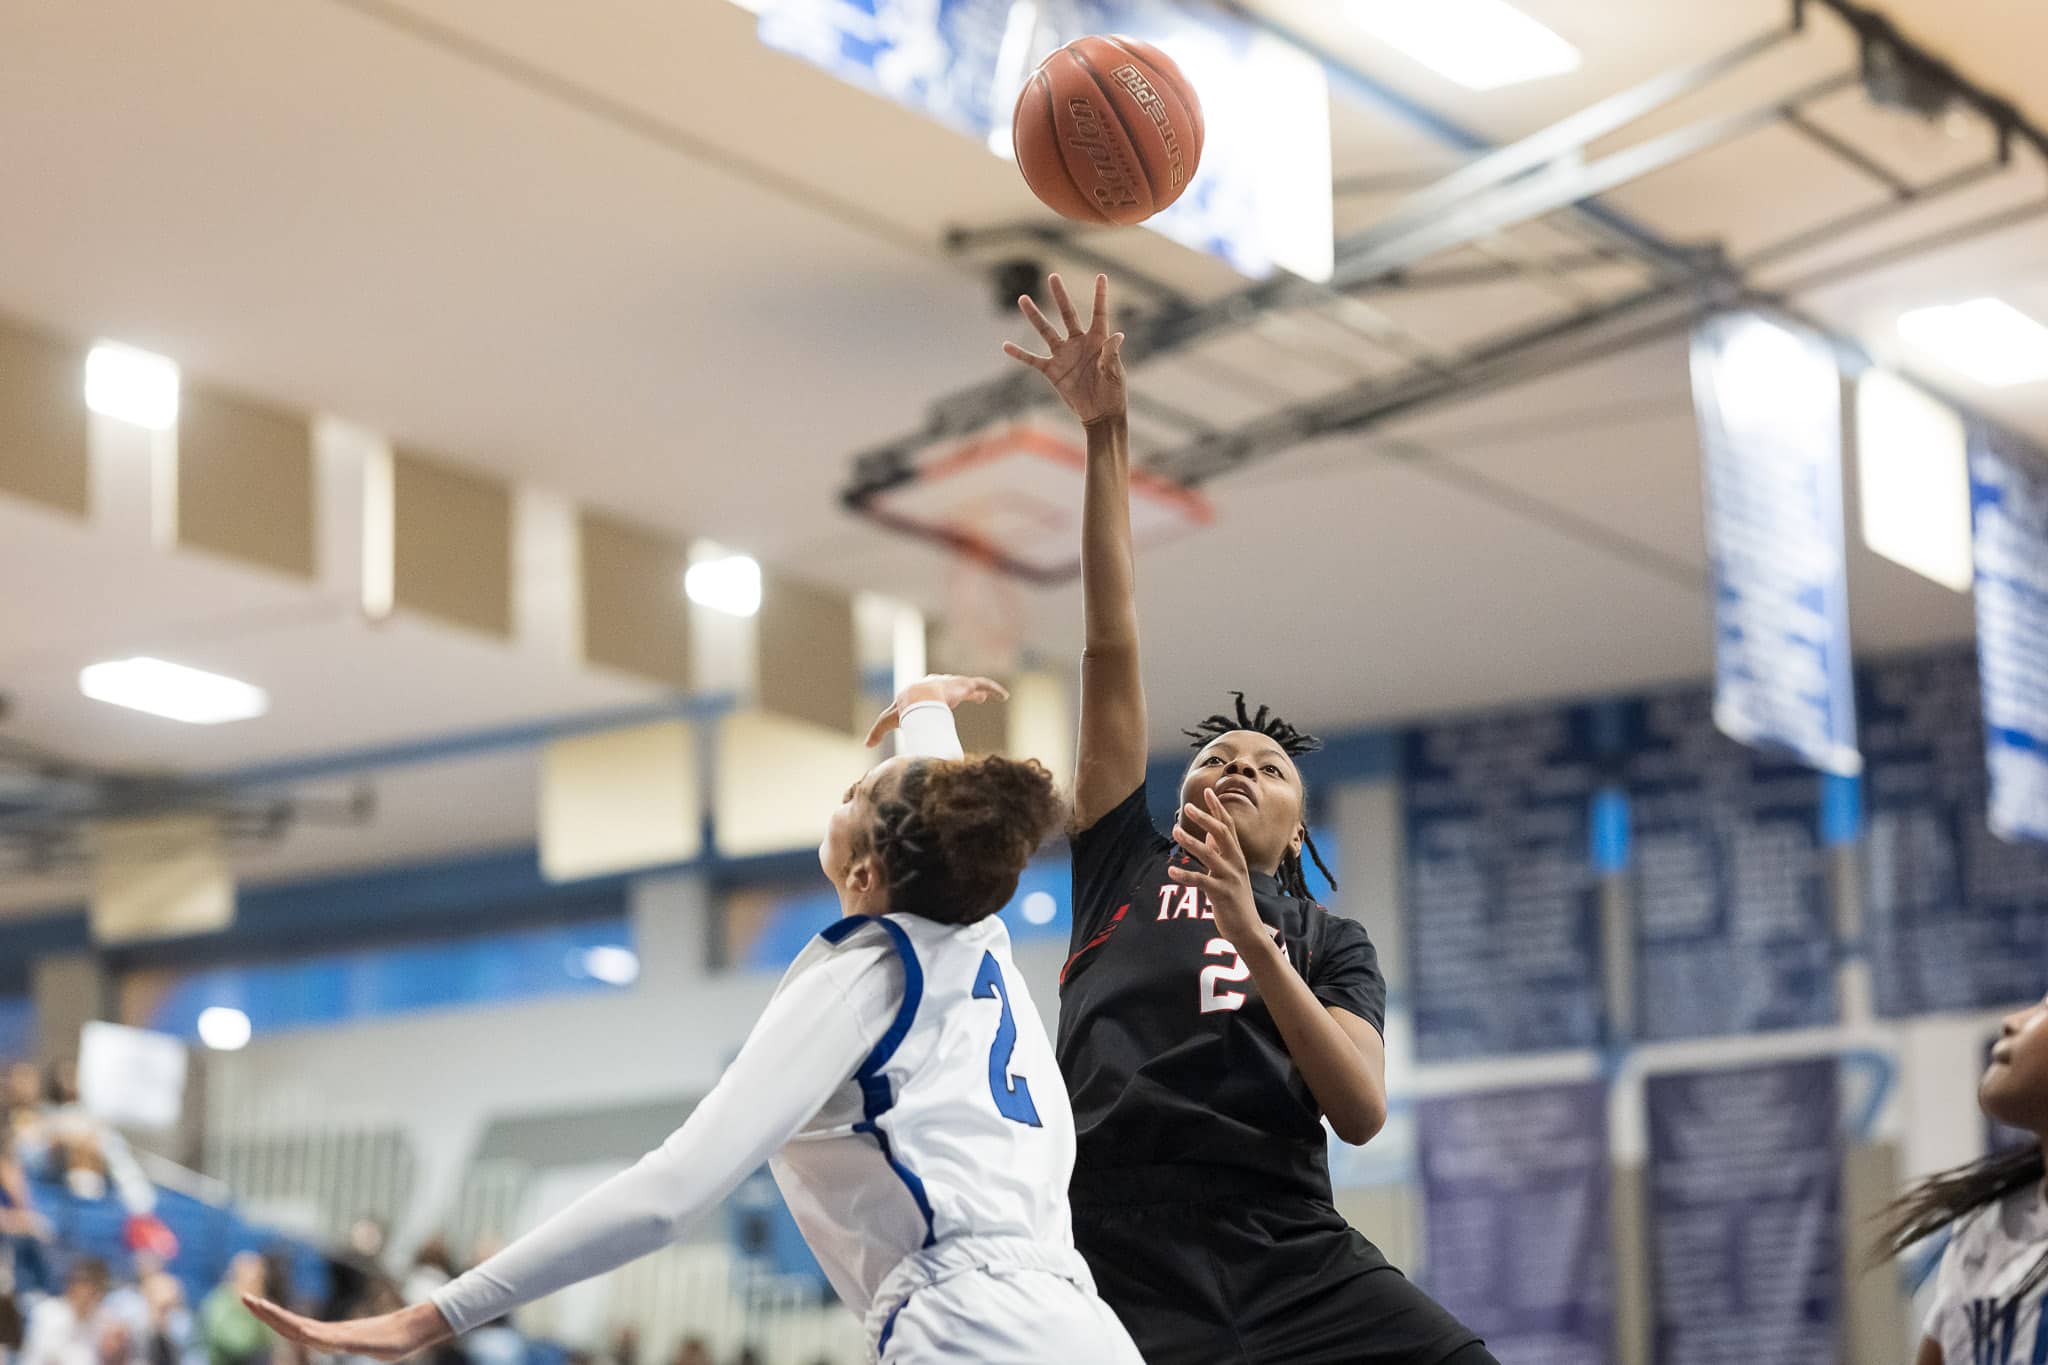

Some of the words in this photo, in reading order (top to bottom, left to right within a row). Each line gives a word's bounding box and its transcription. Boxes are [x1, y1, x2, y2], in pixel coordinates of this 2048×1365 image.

[1116, 65, 1157, 107] PRO
[1068, 97, 1139, 208] Baden
[1147, 101, 1184, 191] ELITE
[1200, 937, 1251, 1013] 2
[972, 949, 1043, 1128] 2
